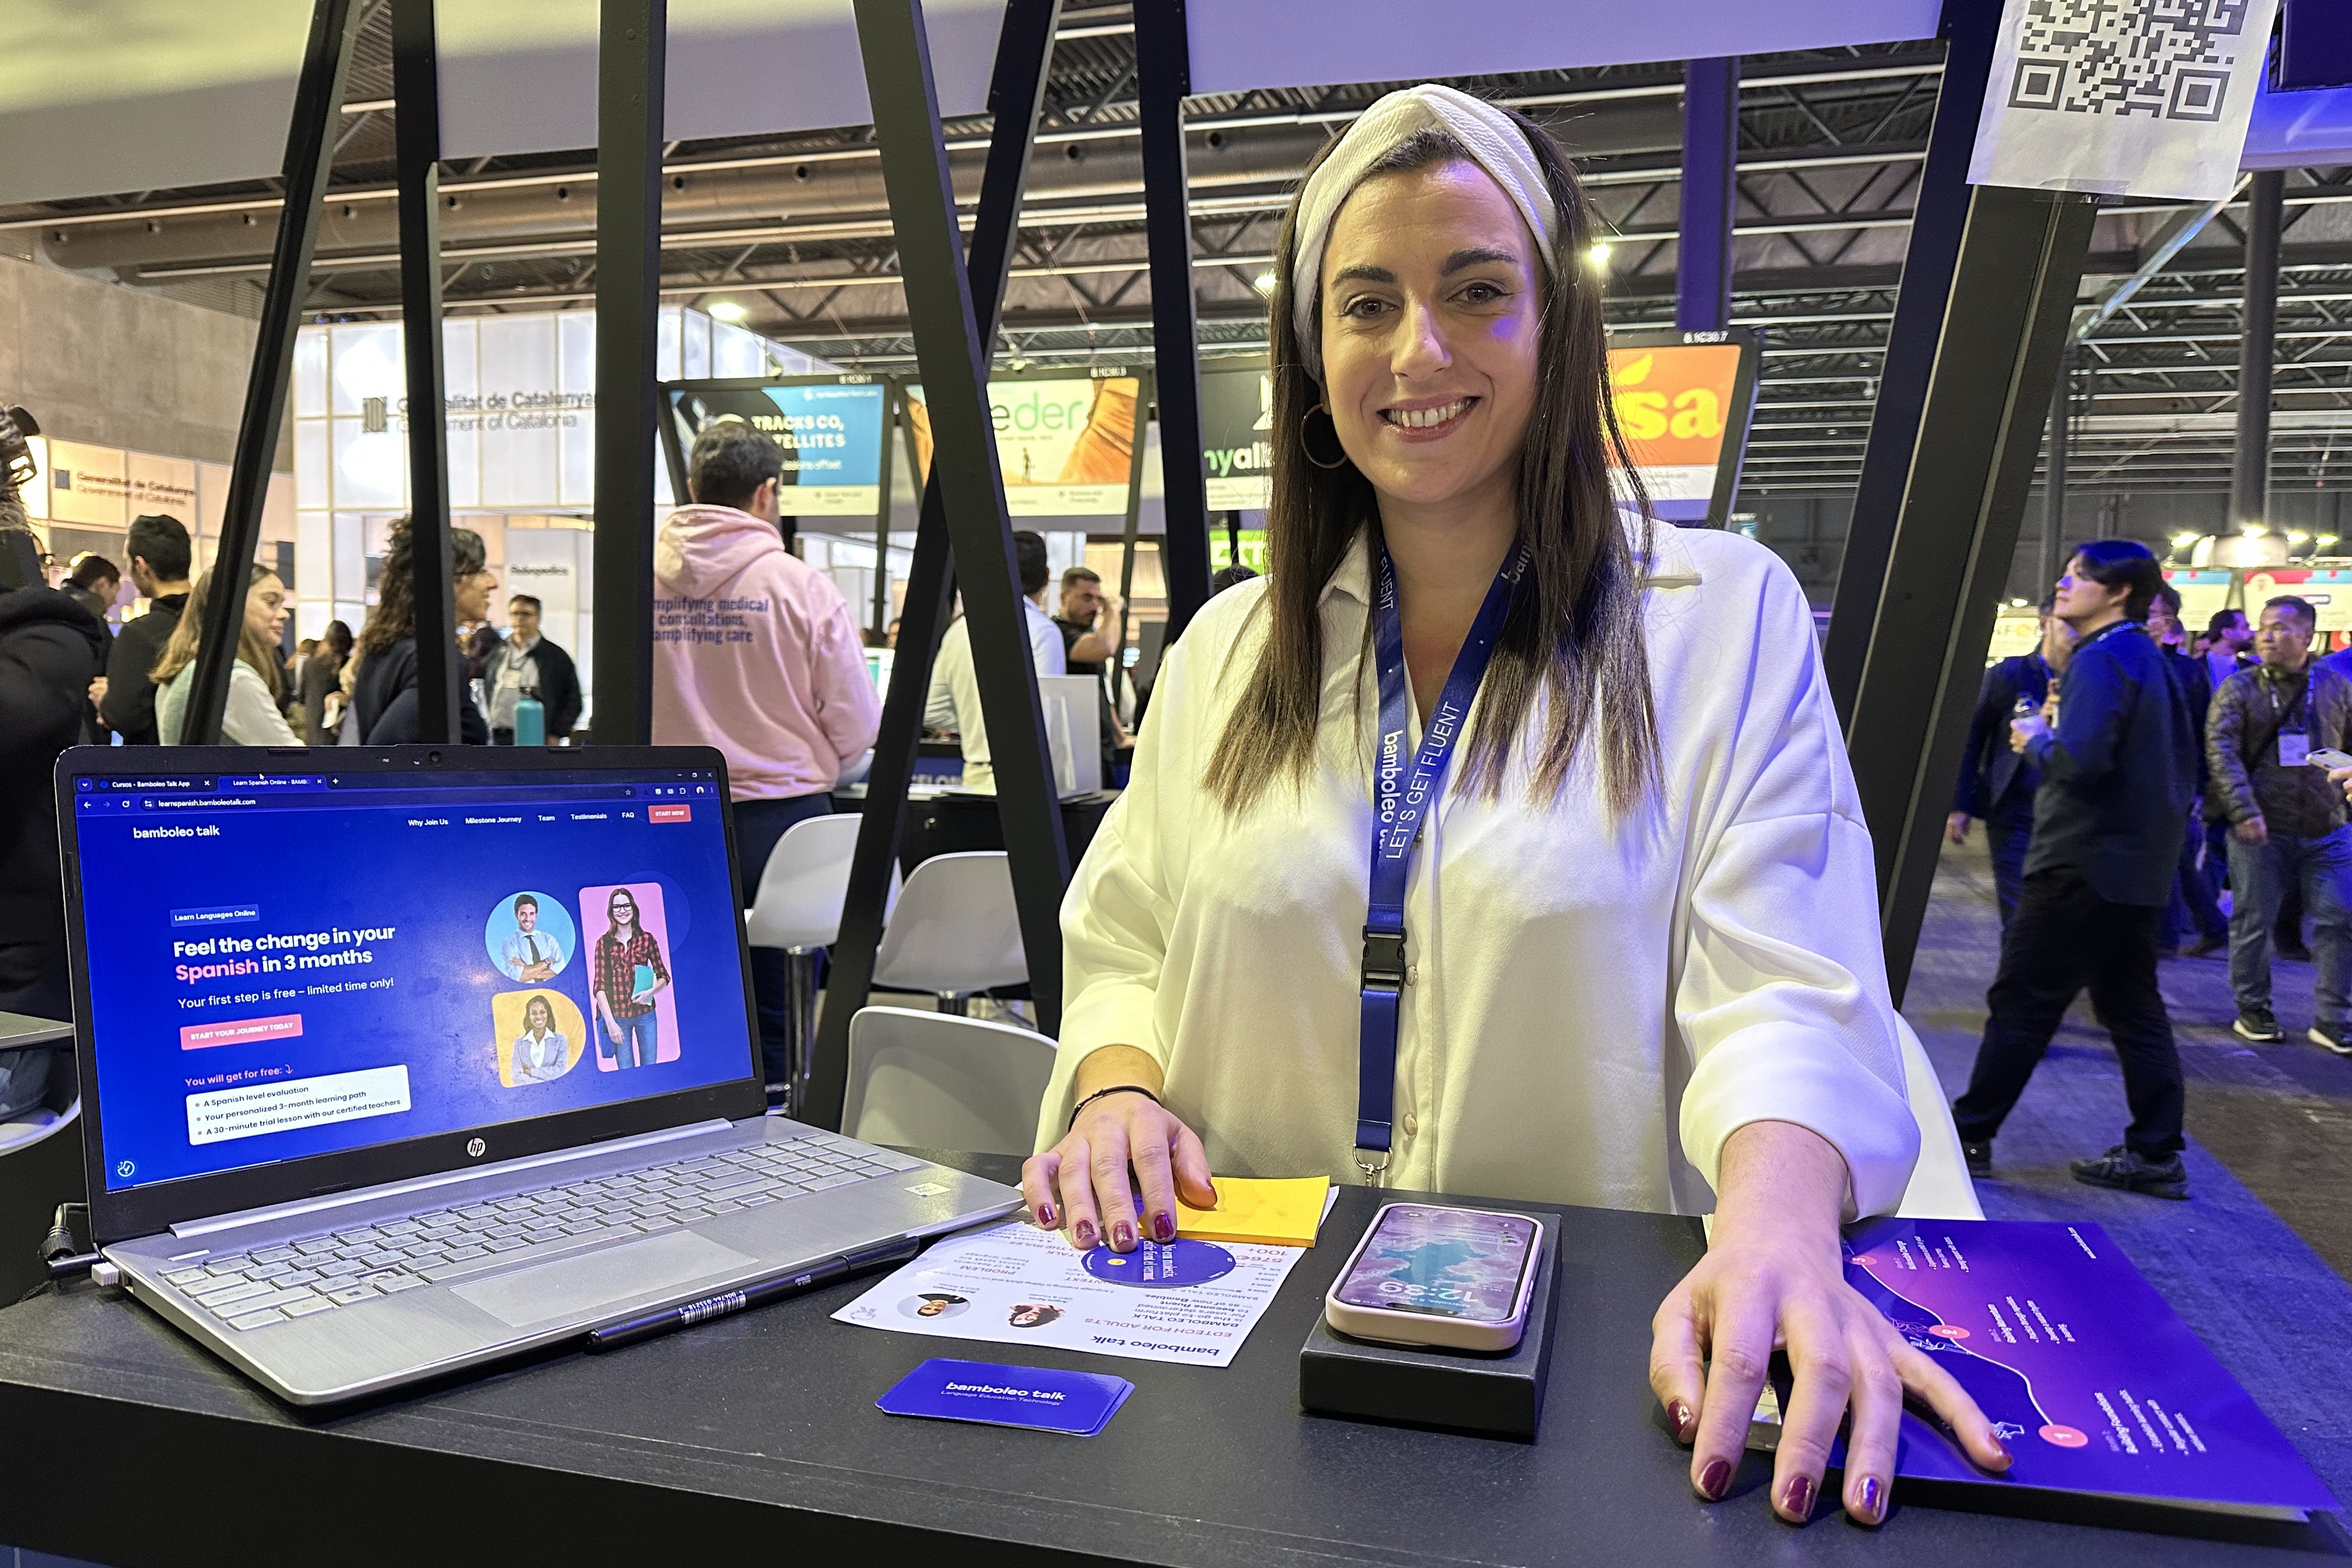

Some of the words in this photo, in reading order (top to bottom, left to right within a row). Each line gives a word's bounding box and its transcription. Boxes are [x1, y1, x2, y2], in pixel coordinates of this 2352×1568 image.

[487, 393, 506, 408] de
[512, 391, 593, 410] Catalunya
[751, 415, 815, 430] TRACKS
[774, 433, 846, 449] TELLITES
[78, 471, 130, 486] Generalitat
[149, 481, 194, 496] Catalunya
[653, 597, 713, 613] mplifying
[718, 598, 769, 612] medical
[726, 630, 754, 642] care
[1381, 730, 1404, 823] bamboleo
[1386, 810, 1416, 859] LET'S
[1406, 768, 1432, 804] GET
[1420, 702, 1461, 765] FLUENT
[158, 798, 256, 808] learnspanish.bamboleotalk.com
[408, 819, 423, 827] Why
[425, 818, 438, 826] Join
[497, 816, 522, 824] Journey
[133, 826, 194, 839] bamboleo
[196, 825, 220, 837] talk
[175, 914, 194, 922] Learn
[196, 912, 233, 921] Languages
[234, 909, 256, 918] Online
[174, 937, 216, 957] Feel
[218, 936, 253, 954] the
[256, 930, 330, 951] change
[332, 928, 351, 943] in
[352, 926, 396, 946] your
[176, 958, 259, 984] Spanish
[262, 956, 281, 972] in
[284, 954, 296, 971] 3
[299, 949, 373, 968] months
[178, 998, 205, 1009] Your
[208, 995, 231, 1006] first
[235, 991, 259, 1005] step
[262, 990, 271, 1000] is
[274, 988, 296, 999] free
[307, 983, 342, 995] limited
[345, 981, 368, 992] time
[370, 977, 394, 991] only!
[190, 1031, 214, 1041] START
[215, 1028, 235, 1038] YOUR
[236, 1024, 268, 1035] JOURNEY
[269, 1022, 293, 1032] TODAY
[185, 1077, 205, 1087] You
[207, 1074, 224, 1084] will
[226, 1072, 243, 1084] get
[244, 1069, 258, 1079] for
[260, 1066, 283, 1077] free:
[211, 1094, 245, 1107] Spanish
[246, 1091, 265, 1101] level
[267, 1086, 309, 1098] evaluation
[205, 1113, 224, 1122] Your
[226, 1103, 278, 1120] personalized
[279, 1097, 314, 1111] 3-month
[316, 1094, 348, 1108] learning
[349, 1090, 367, 1101] path
[214, 1121, 258, 1135] 30-minute
[260, 1118, 276, 1127] trial
[277, 1114, 302, 1124] lesson
[304, 1110, 321, 1120] with
[337, 1102, 368, 1115] certified
[369, 1097, 401, 1110] teachers
[470, 1138, 483, 1156] hp
[960, 1265, 1016, 1275] PROBLEM
[1206, 1292, 1259, 1301] BAMBOLEO
[1378, 1281, 1479, 1303] 12:39
[1134, 1308, 1181, 1318] platform
[1136, 1303, 1197, 1314] determined
[1159, 1301, 1192, 1309] fluent
[1194, 1304, 1236, 1312] become
[1083, 1318, 1141, 1330] ADULTS
[1142, 1324, 1173, 1334] FOR
[1167, 1318, 1239, 1328] BAMBOLEO
[1174, 1328, 1233, 1338] EDTECH
[1090, 1335, 1126, 1348] talk
[1130, 1340, 1220, 1357] bamboleo
[940, 1390, 978, 1398] Language
[978, 1393, 1017, 1401] Education
[1019, 1397, 1062, 1406] Technology
[946, 1382, 1029, 1397] bamboleo
[1031, 1390, 1067, 1402] talk
[2115, 1427, 2139, 1454] Building
